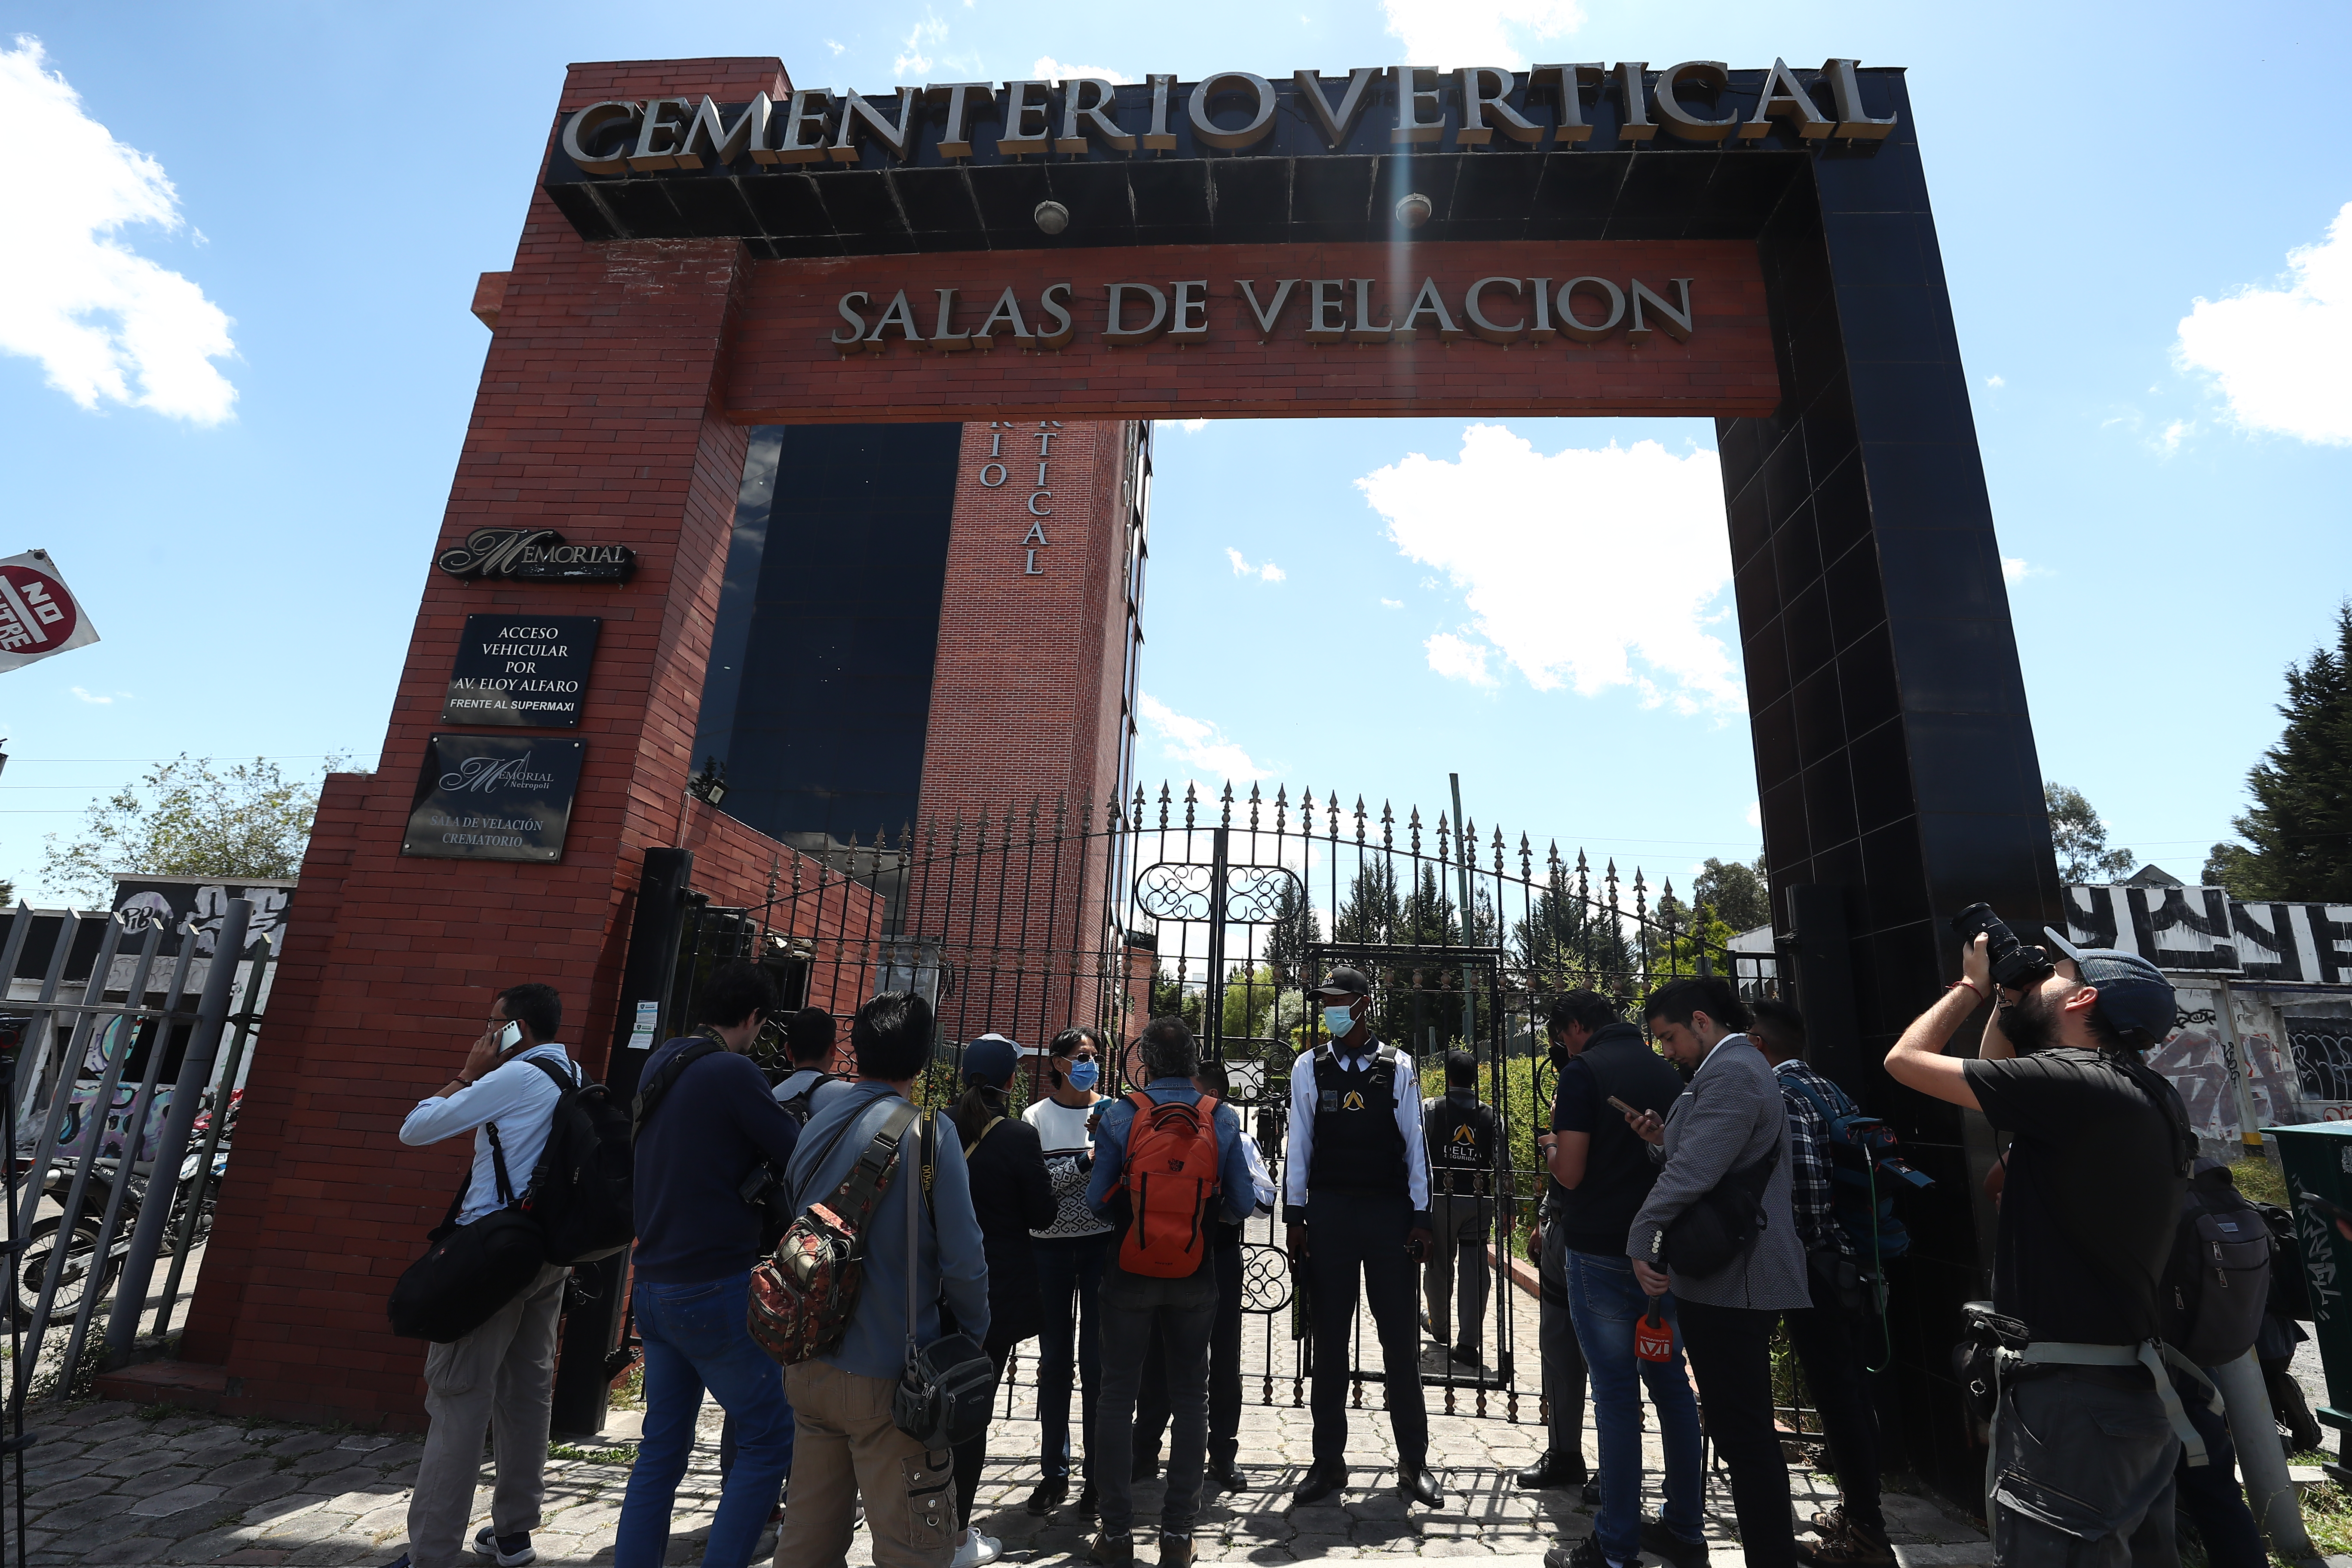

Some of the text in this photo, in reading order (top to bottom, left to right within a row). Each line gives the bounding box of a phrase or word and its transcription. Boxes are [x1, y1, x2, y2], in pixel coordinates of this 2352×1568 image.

[561, 56, 1898, 174] CEMENTERIO VERTICAL
[831, 276, 1694, 352] SALAS DE VELACION
[20, 581, 64, 625] NO
[498, 627, 559, 640] ACCESO
[482, 643, 568, 657] VEHICULAR
[505, 662, 537, 674] POR
[453, 677, 579, 693] AV. ELOY ALFARO
[450, 699, 575, 712] FRENTE AL SUPERMAXI
[430, 815, 543, 831] SALA DE VELACIÓN
[442, 833, 523, 848] CREMATORIO
[1444, 1153, 1476, 1161] SEGURIDA
[922, 1165, 932, 1191] D500
